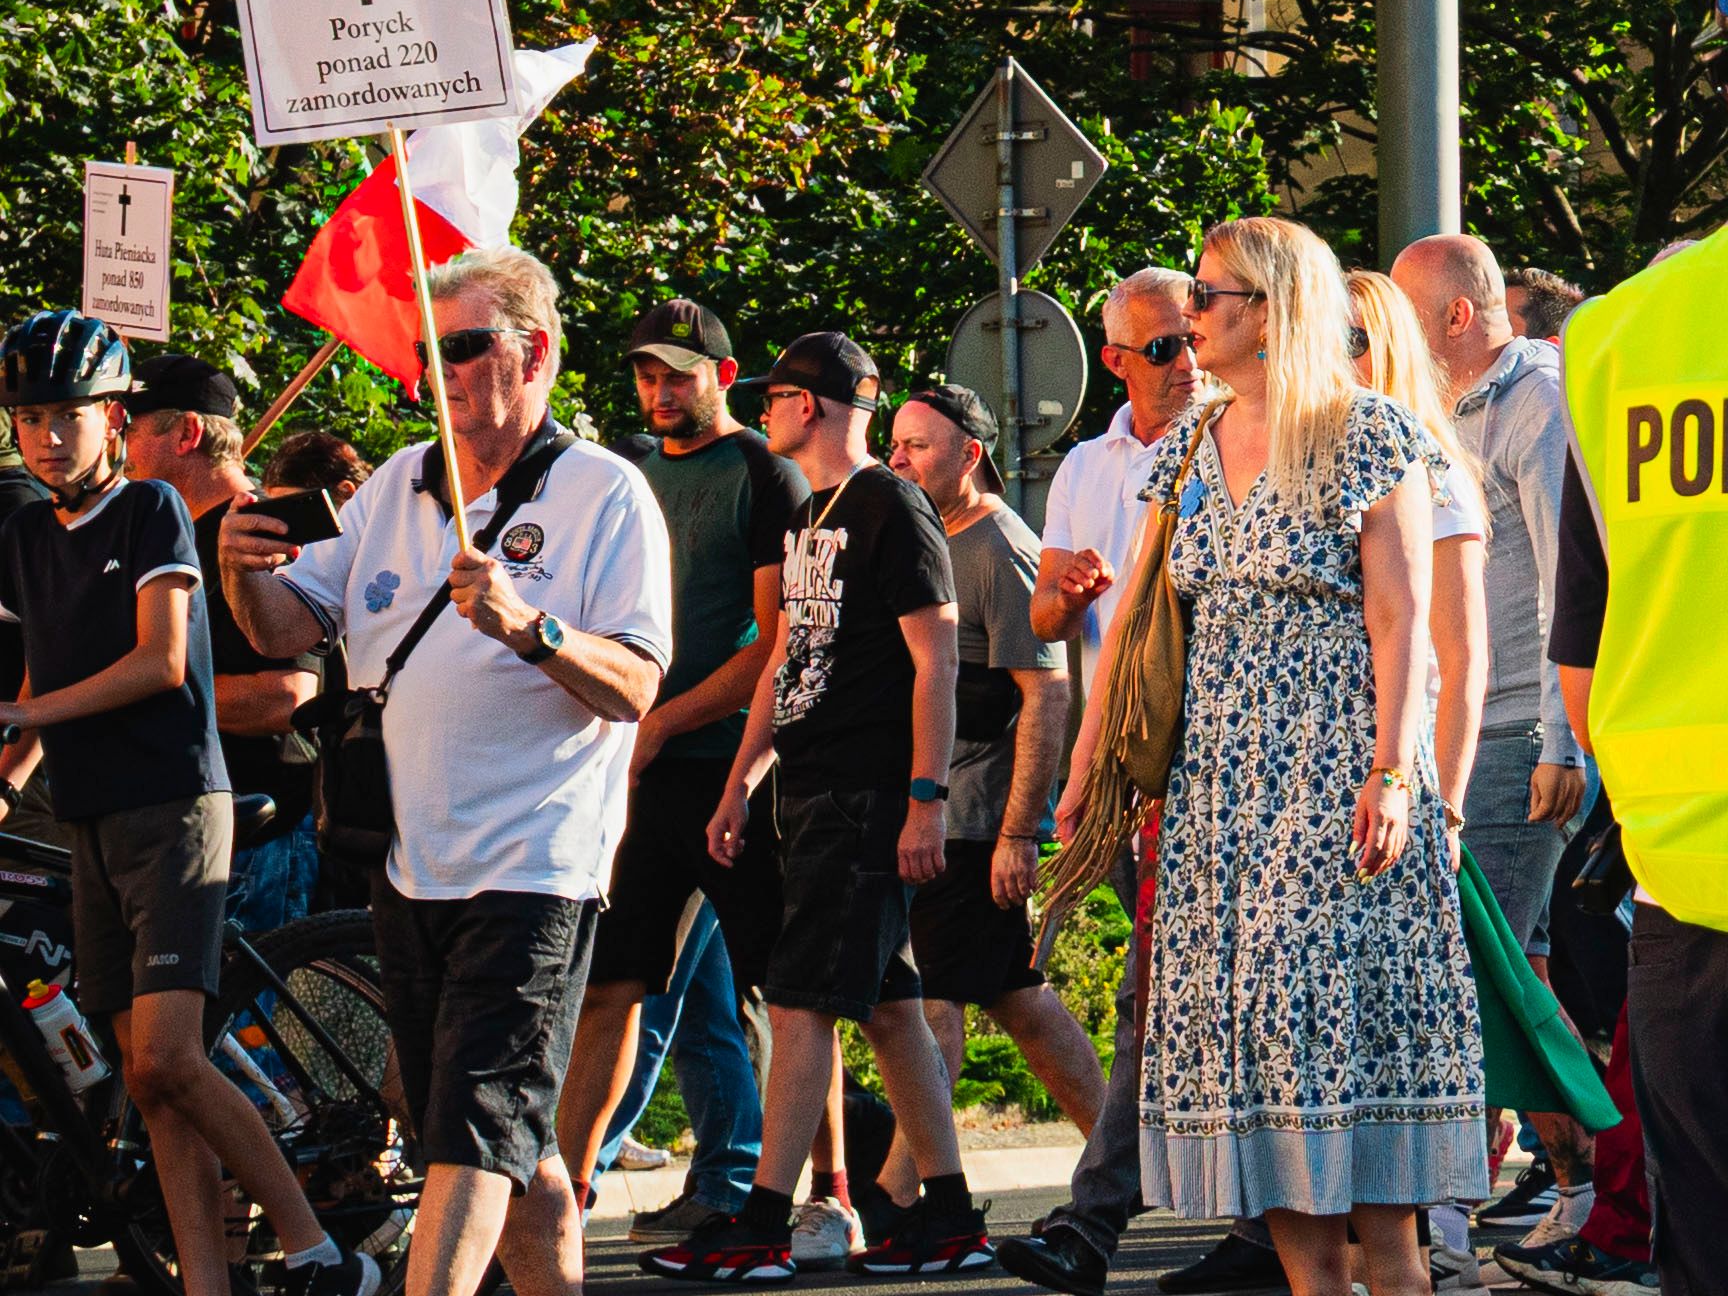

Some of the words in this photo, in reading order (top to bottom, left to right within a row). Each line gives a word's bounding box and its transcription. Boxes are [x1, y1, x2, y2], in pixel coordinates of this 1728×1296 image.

[329, 11, 415, 43] Poryck
[316, 47, 391, 84] ponad
[399, 41, 438, 67] 220
[286, 71, 482, 114] zamordowanych
[95, 239, 113, 258] Huta
[101, 269, 127, 291] ponad
[128, 270, 145, 289] 850
[92, 295, 155, 321] zamordowanych
[147, 954, 180, 968] JAKO
